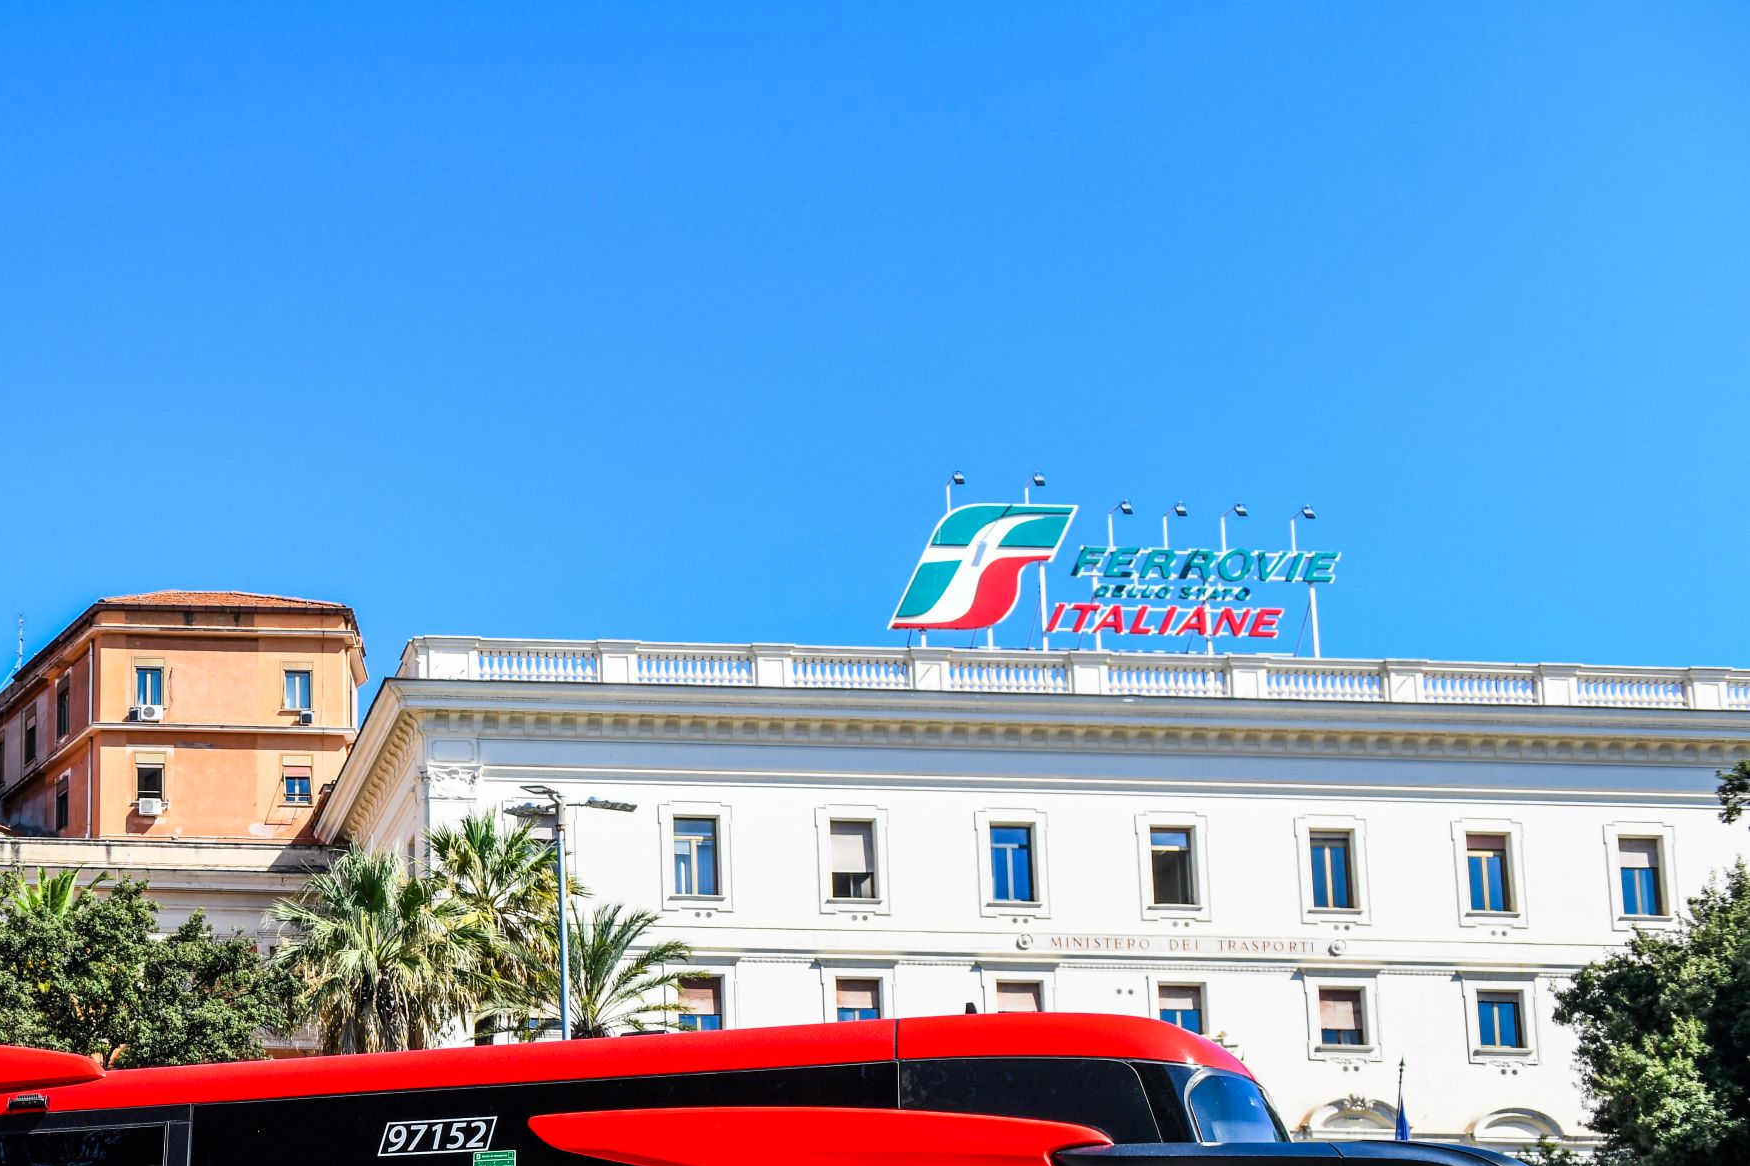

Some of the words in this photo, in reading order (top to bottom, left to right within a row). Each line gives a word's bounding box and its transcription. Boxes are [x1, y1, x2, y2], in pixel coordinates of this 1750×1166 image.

[1071, 546, 1342, 584] FERROVIE
[1094, 584, 1170, 599] DELLO
[1178, 586, 1251, 602] STATO
[1047, 603, 1285, 638] ITALIANE
[1050, 936, 1151, 951] MINISTERO
[1169, 938, 1200, 952] DEI
[1218, 939, 1315, 953] TRASPORTI
[387, 1121, 487, 1152] 97152
